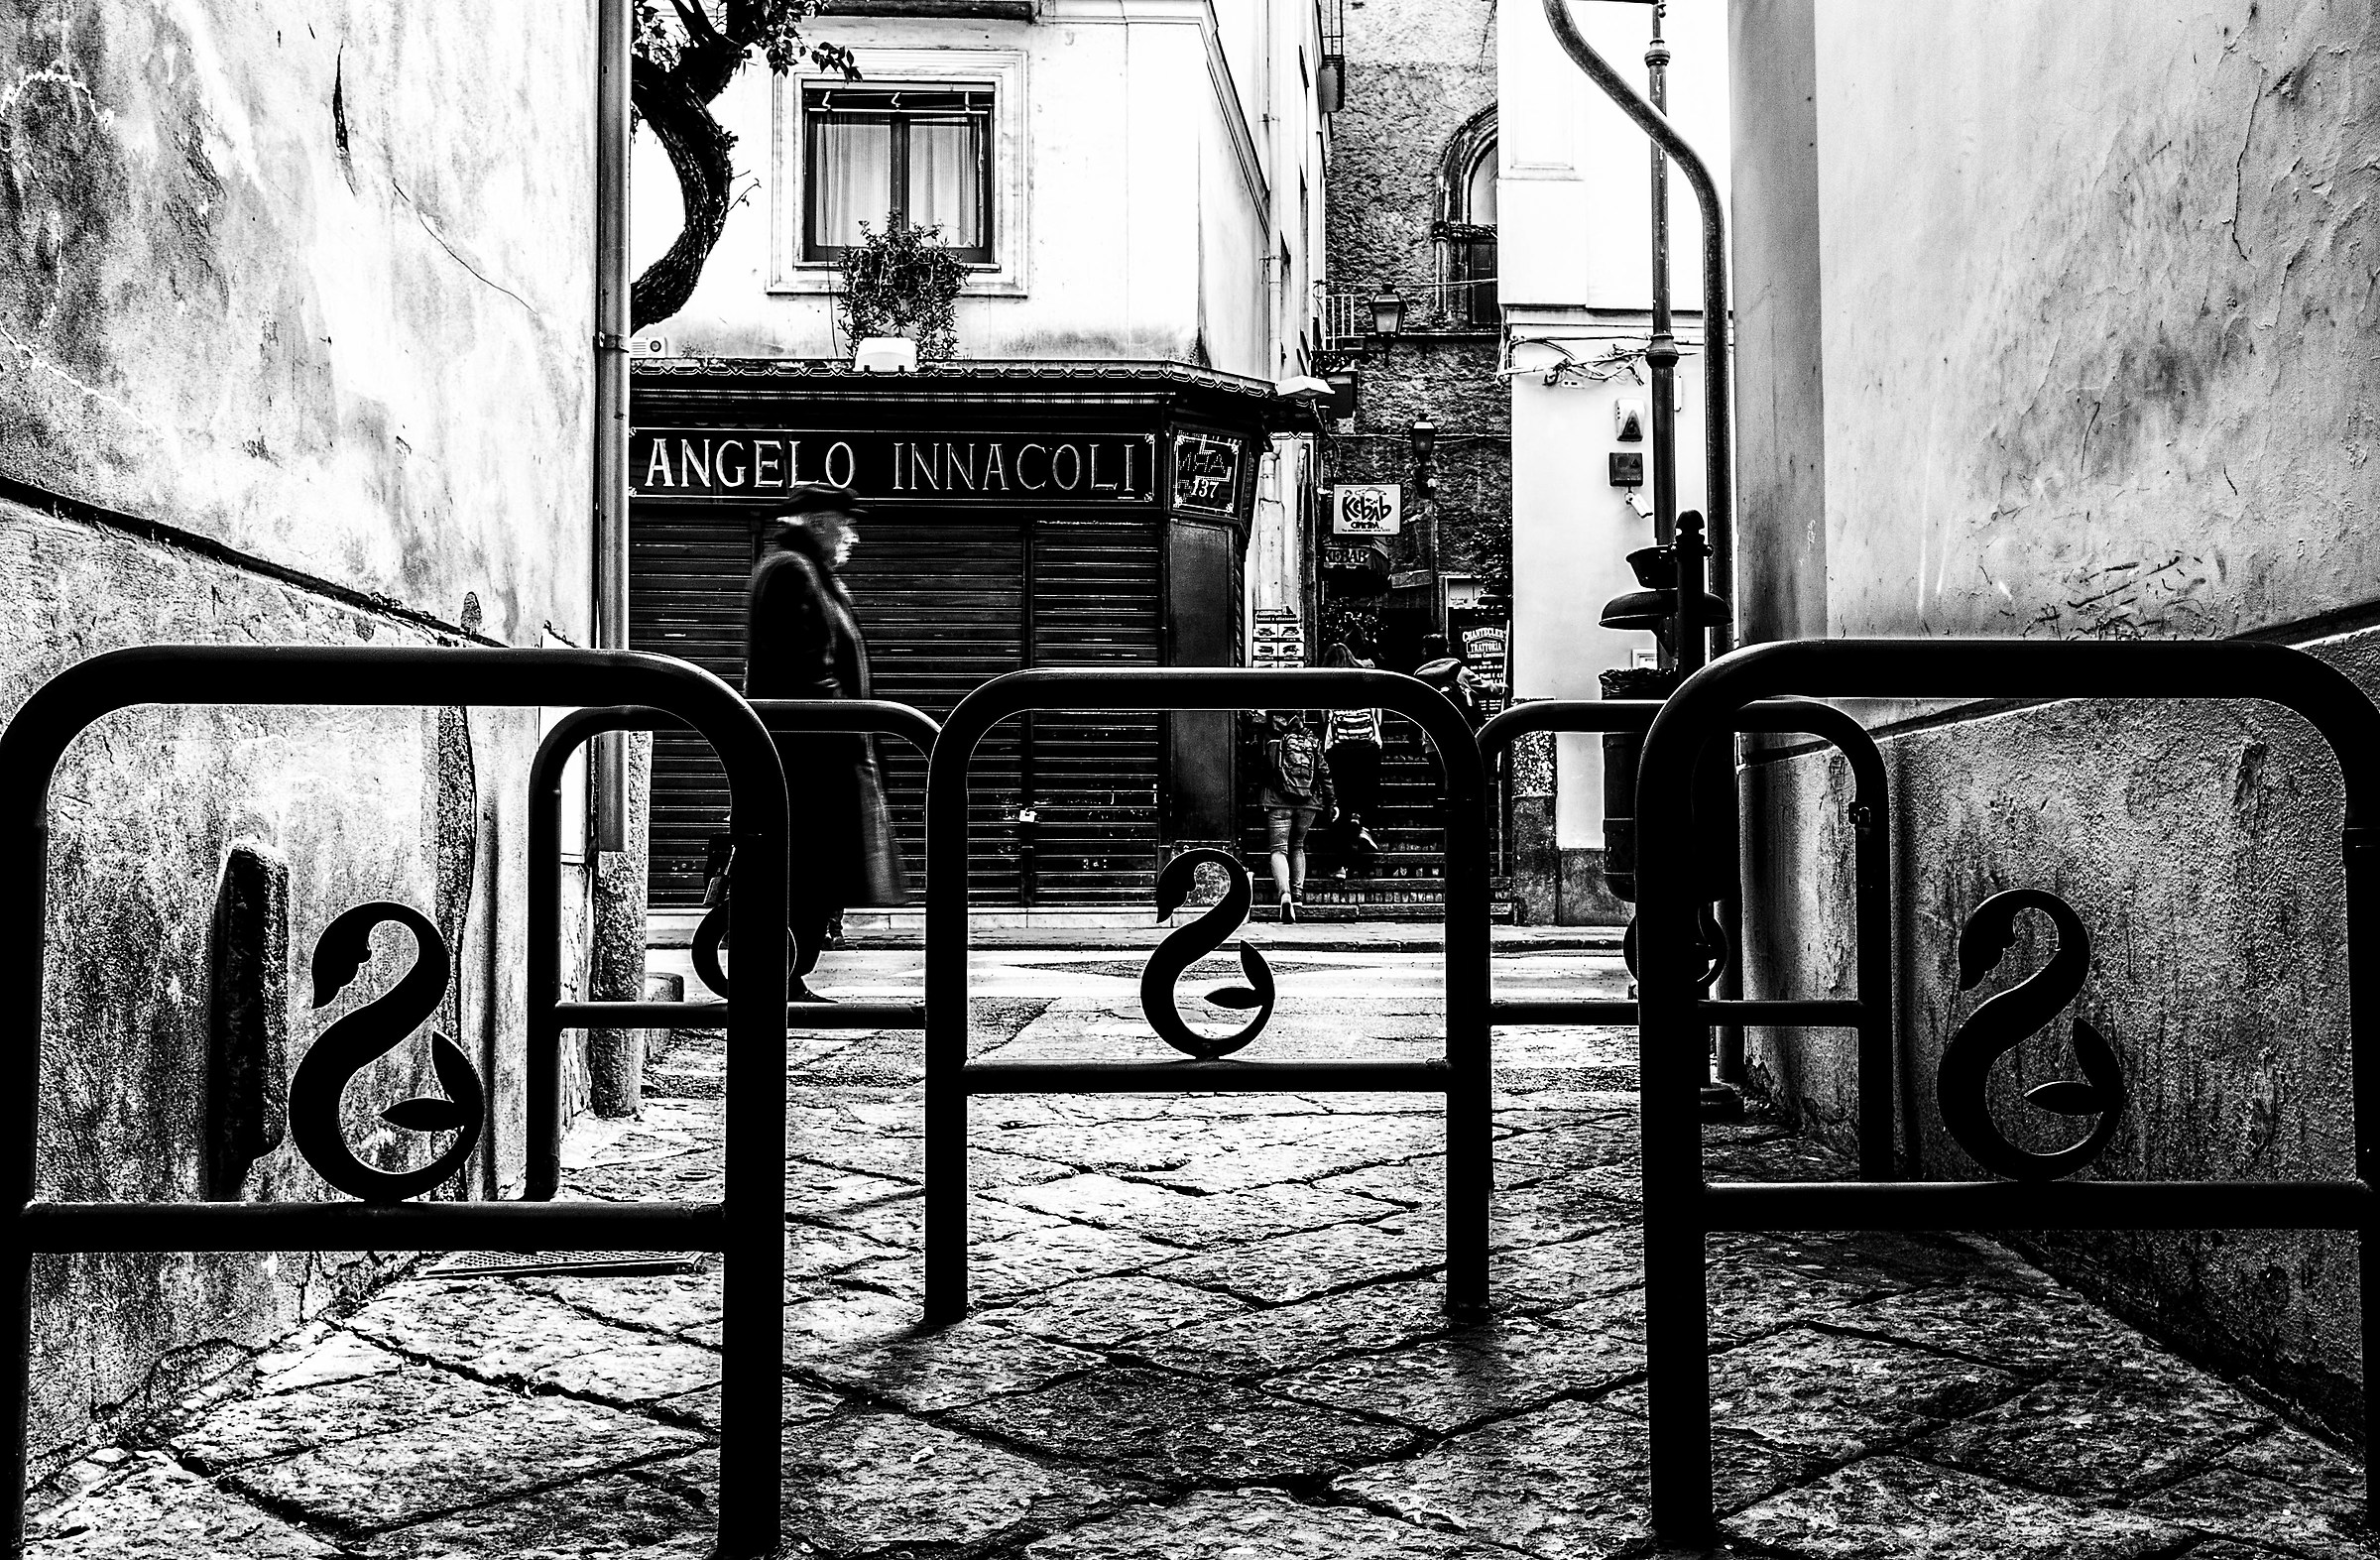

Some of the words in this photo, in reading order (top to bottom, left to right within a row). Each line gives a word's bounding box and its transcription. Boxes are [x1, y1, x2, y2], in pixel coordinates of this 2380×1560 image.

[645, 438, 855, 489] ANGELO
[892, 442, 1134, 491] INNACOLI
[1191, 476, 1220, 499] 137
[1325, 548, 1369, 563] KEBAB
[1470, 642, 1502, 653] TRATTORIA
